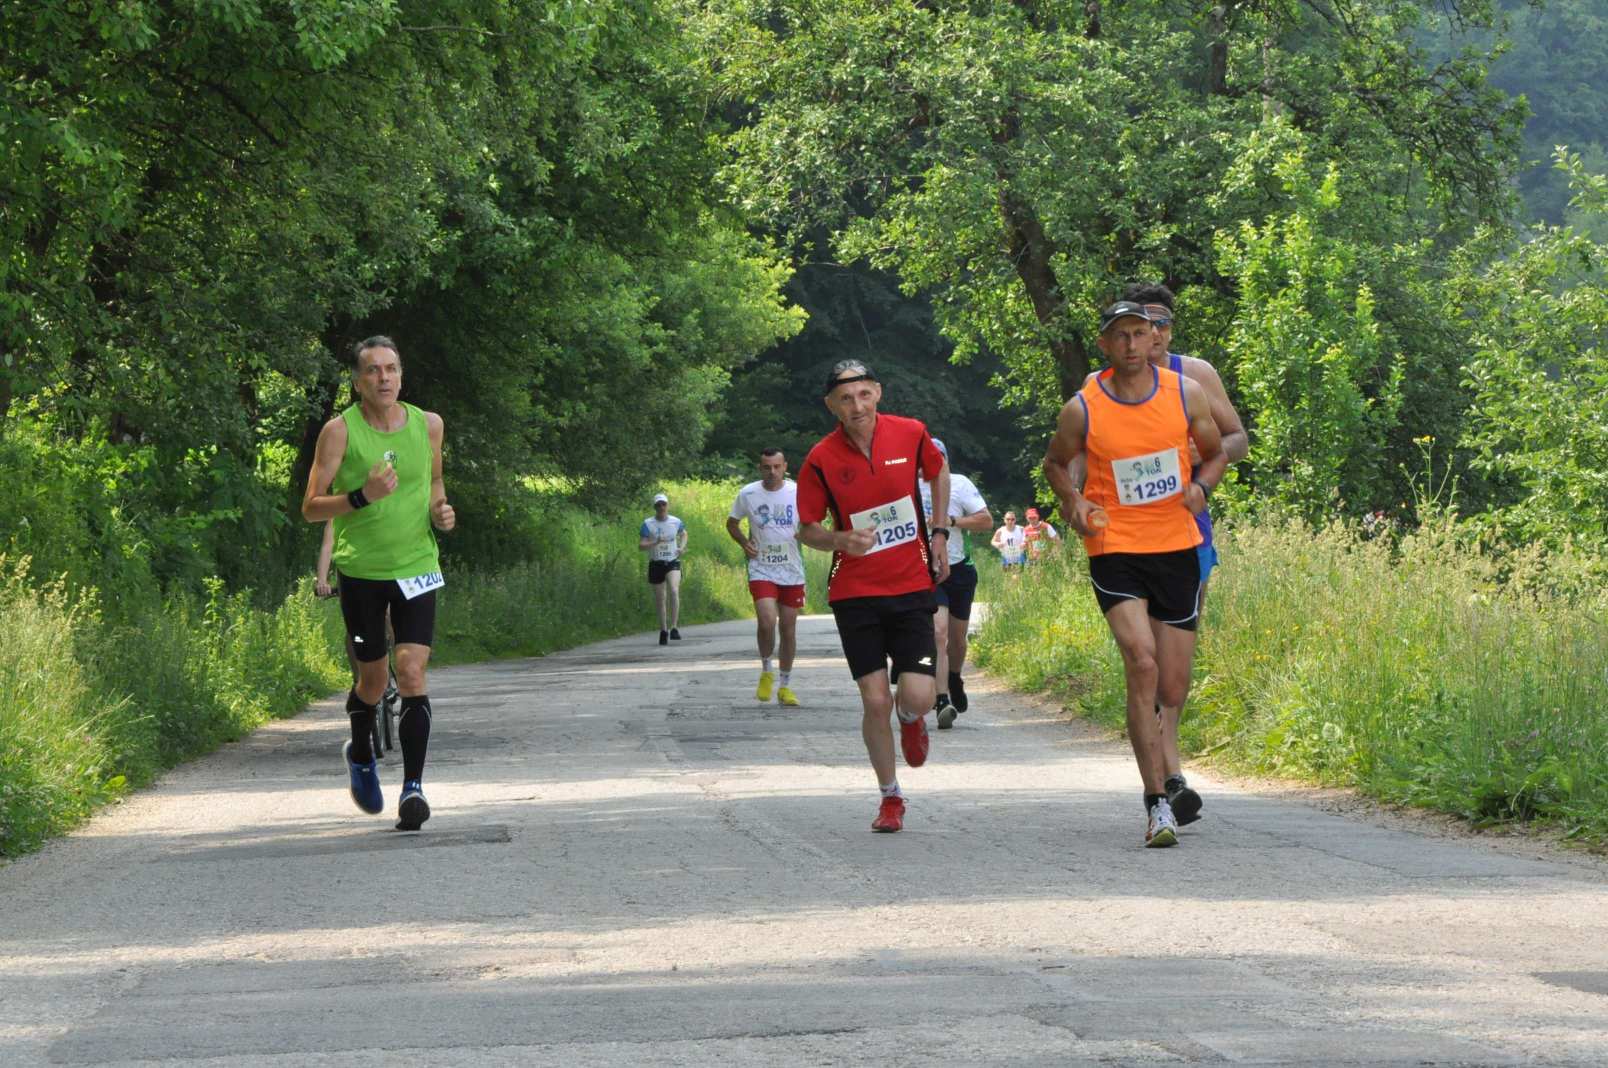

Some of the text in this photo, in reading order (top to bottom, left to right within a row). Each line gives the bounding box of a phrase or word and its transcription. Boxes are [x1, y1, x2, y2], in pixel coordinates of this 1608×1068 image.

[1134, 475, 1177, 499] 1299
[876, 522, 916, 546] 1205
[767, 554, 788, 563] 1204
